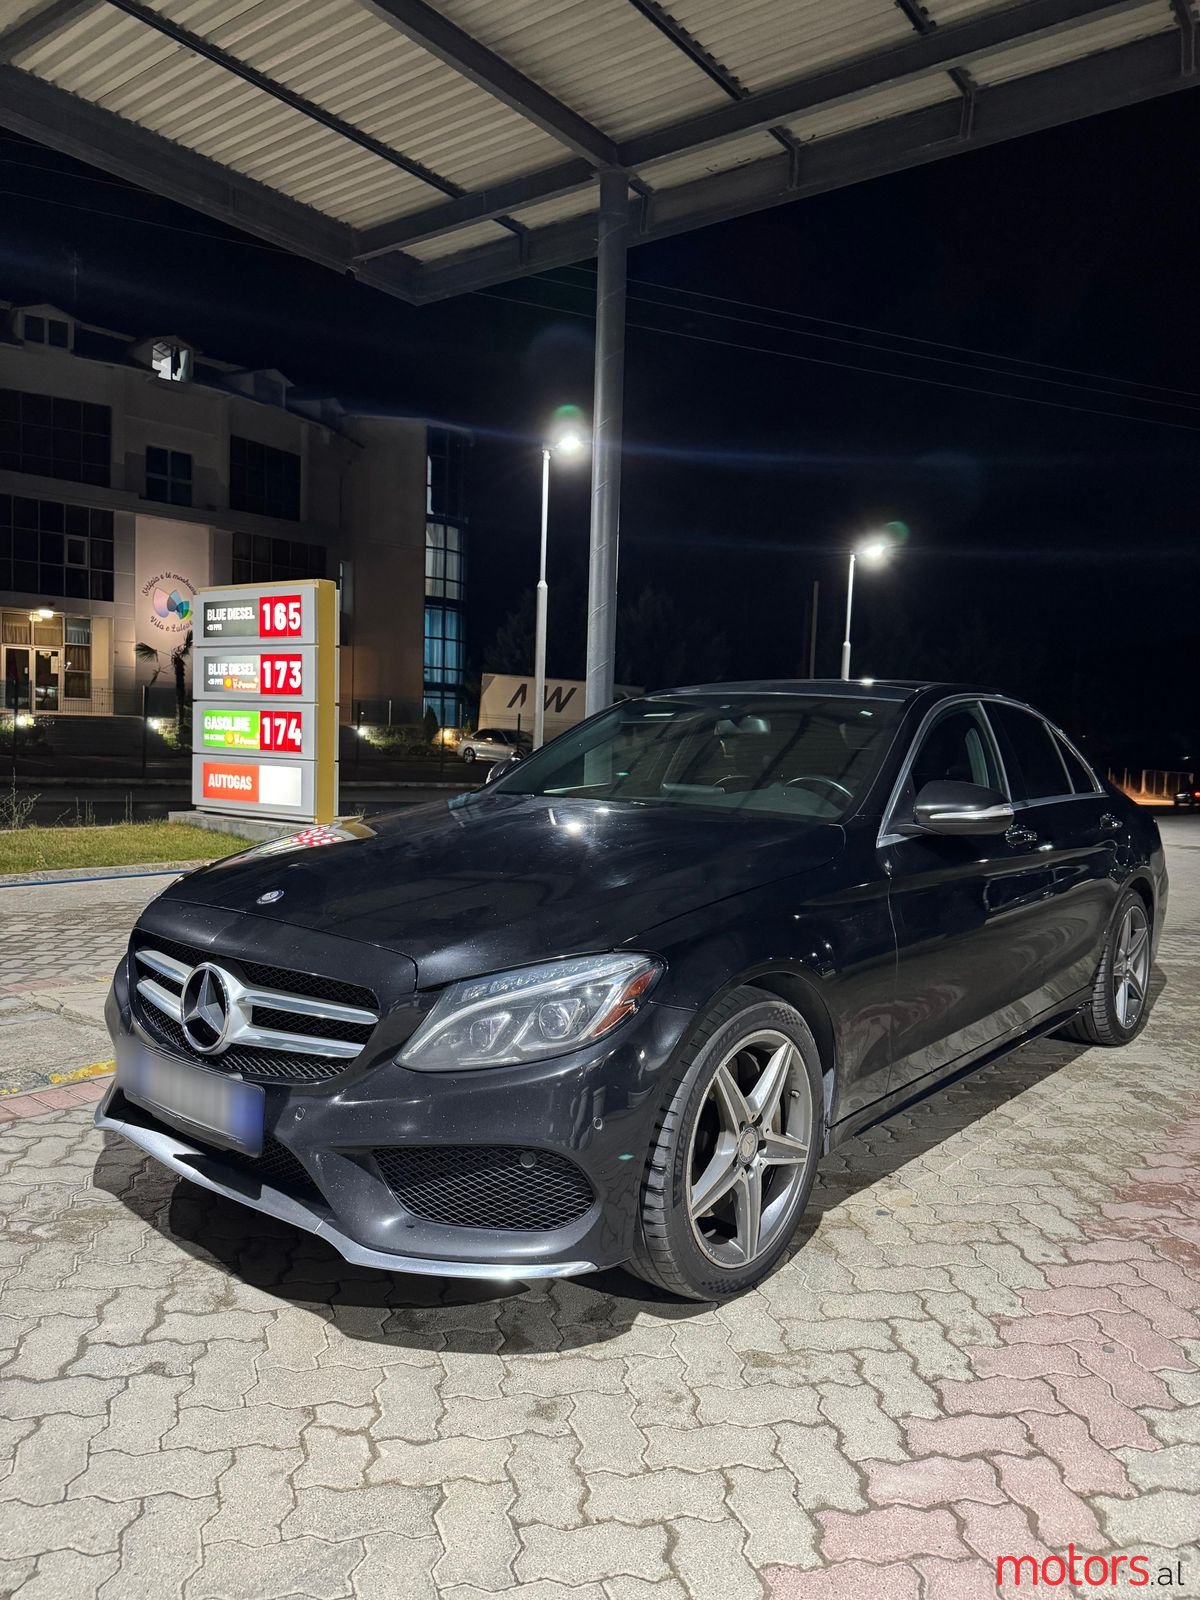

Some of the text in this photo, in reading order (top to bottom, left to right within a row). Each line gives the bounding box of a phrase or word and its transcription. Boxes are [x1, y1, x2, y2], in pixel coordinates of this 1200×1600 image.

[206, 606, 256, 621] BLUE DIESEL
[262, 602, 301, 631] 165
[207, 663, 257, 676] BLUE DIESEL
[262, 660, 302, 689] 173
[204, 715, 251, 732] GASOLINE
[262, 717, 302, 746] 174
[208, 773, 253, 791] AUTOGAS
